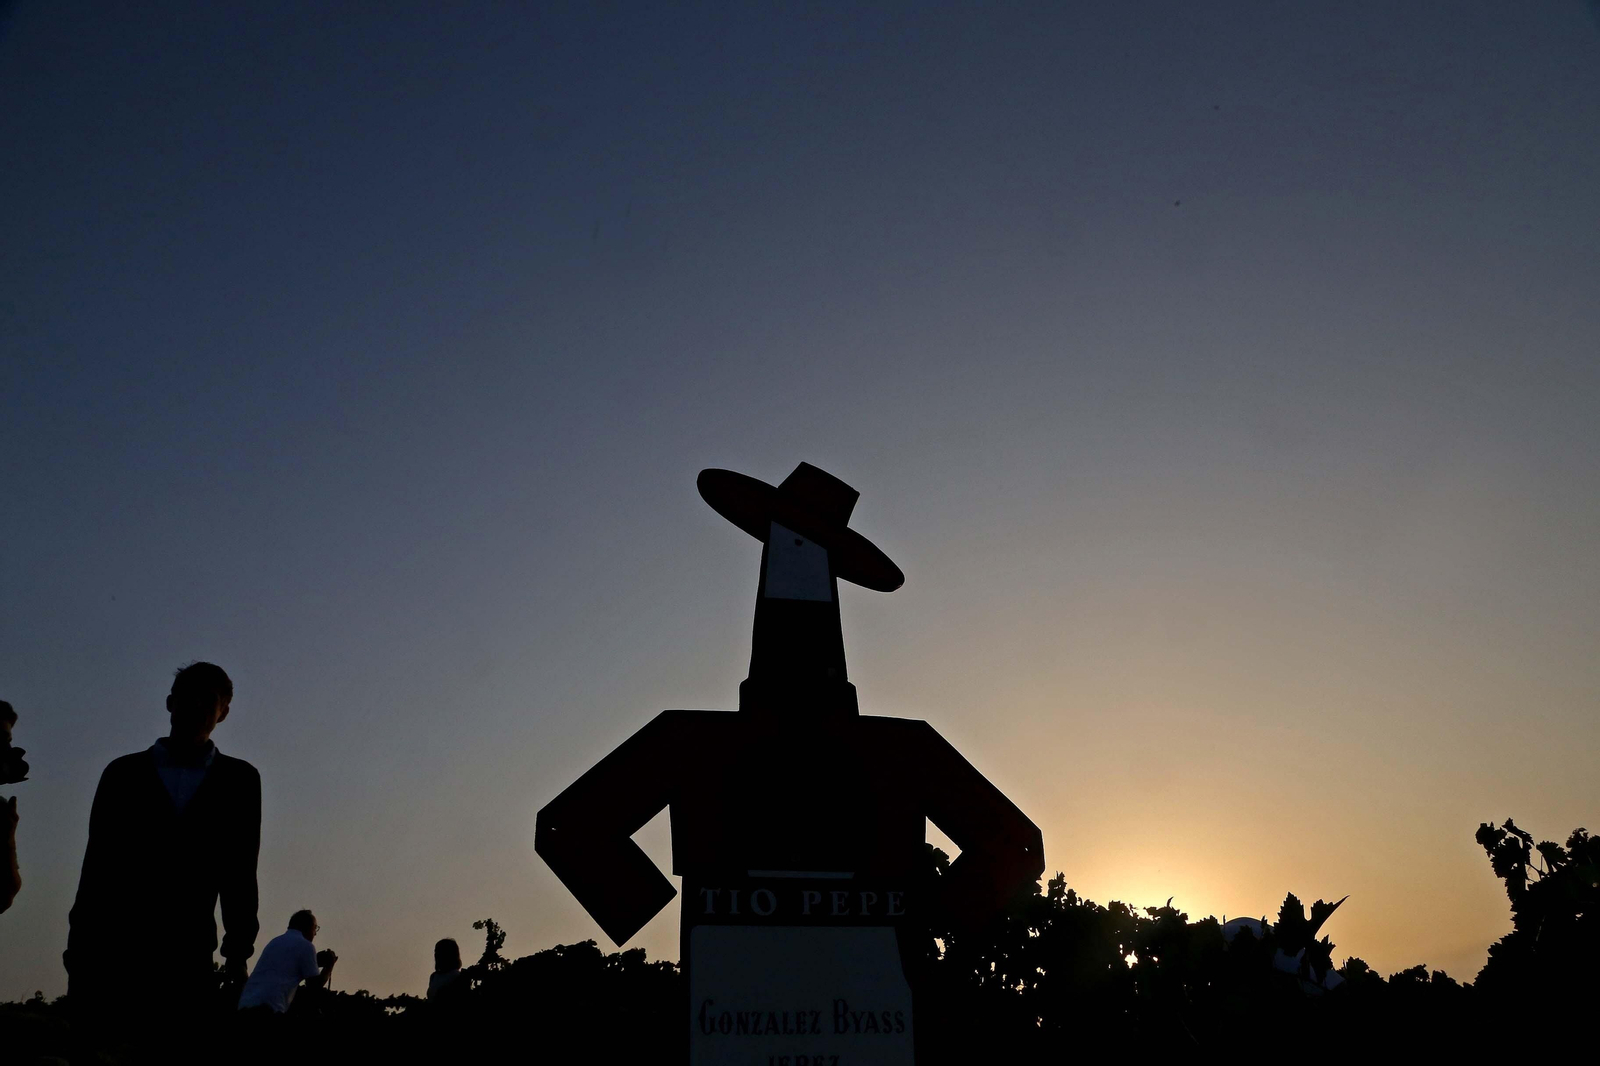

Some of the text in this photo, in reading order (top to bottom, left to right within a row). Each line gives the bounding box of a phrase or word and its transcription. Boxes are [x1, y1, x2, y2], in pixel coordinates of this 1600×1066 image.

[700, 887, 906, 916] TIO PEPE
[698, 998, 905, 1035] GONZALEZ BYASS
